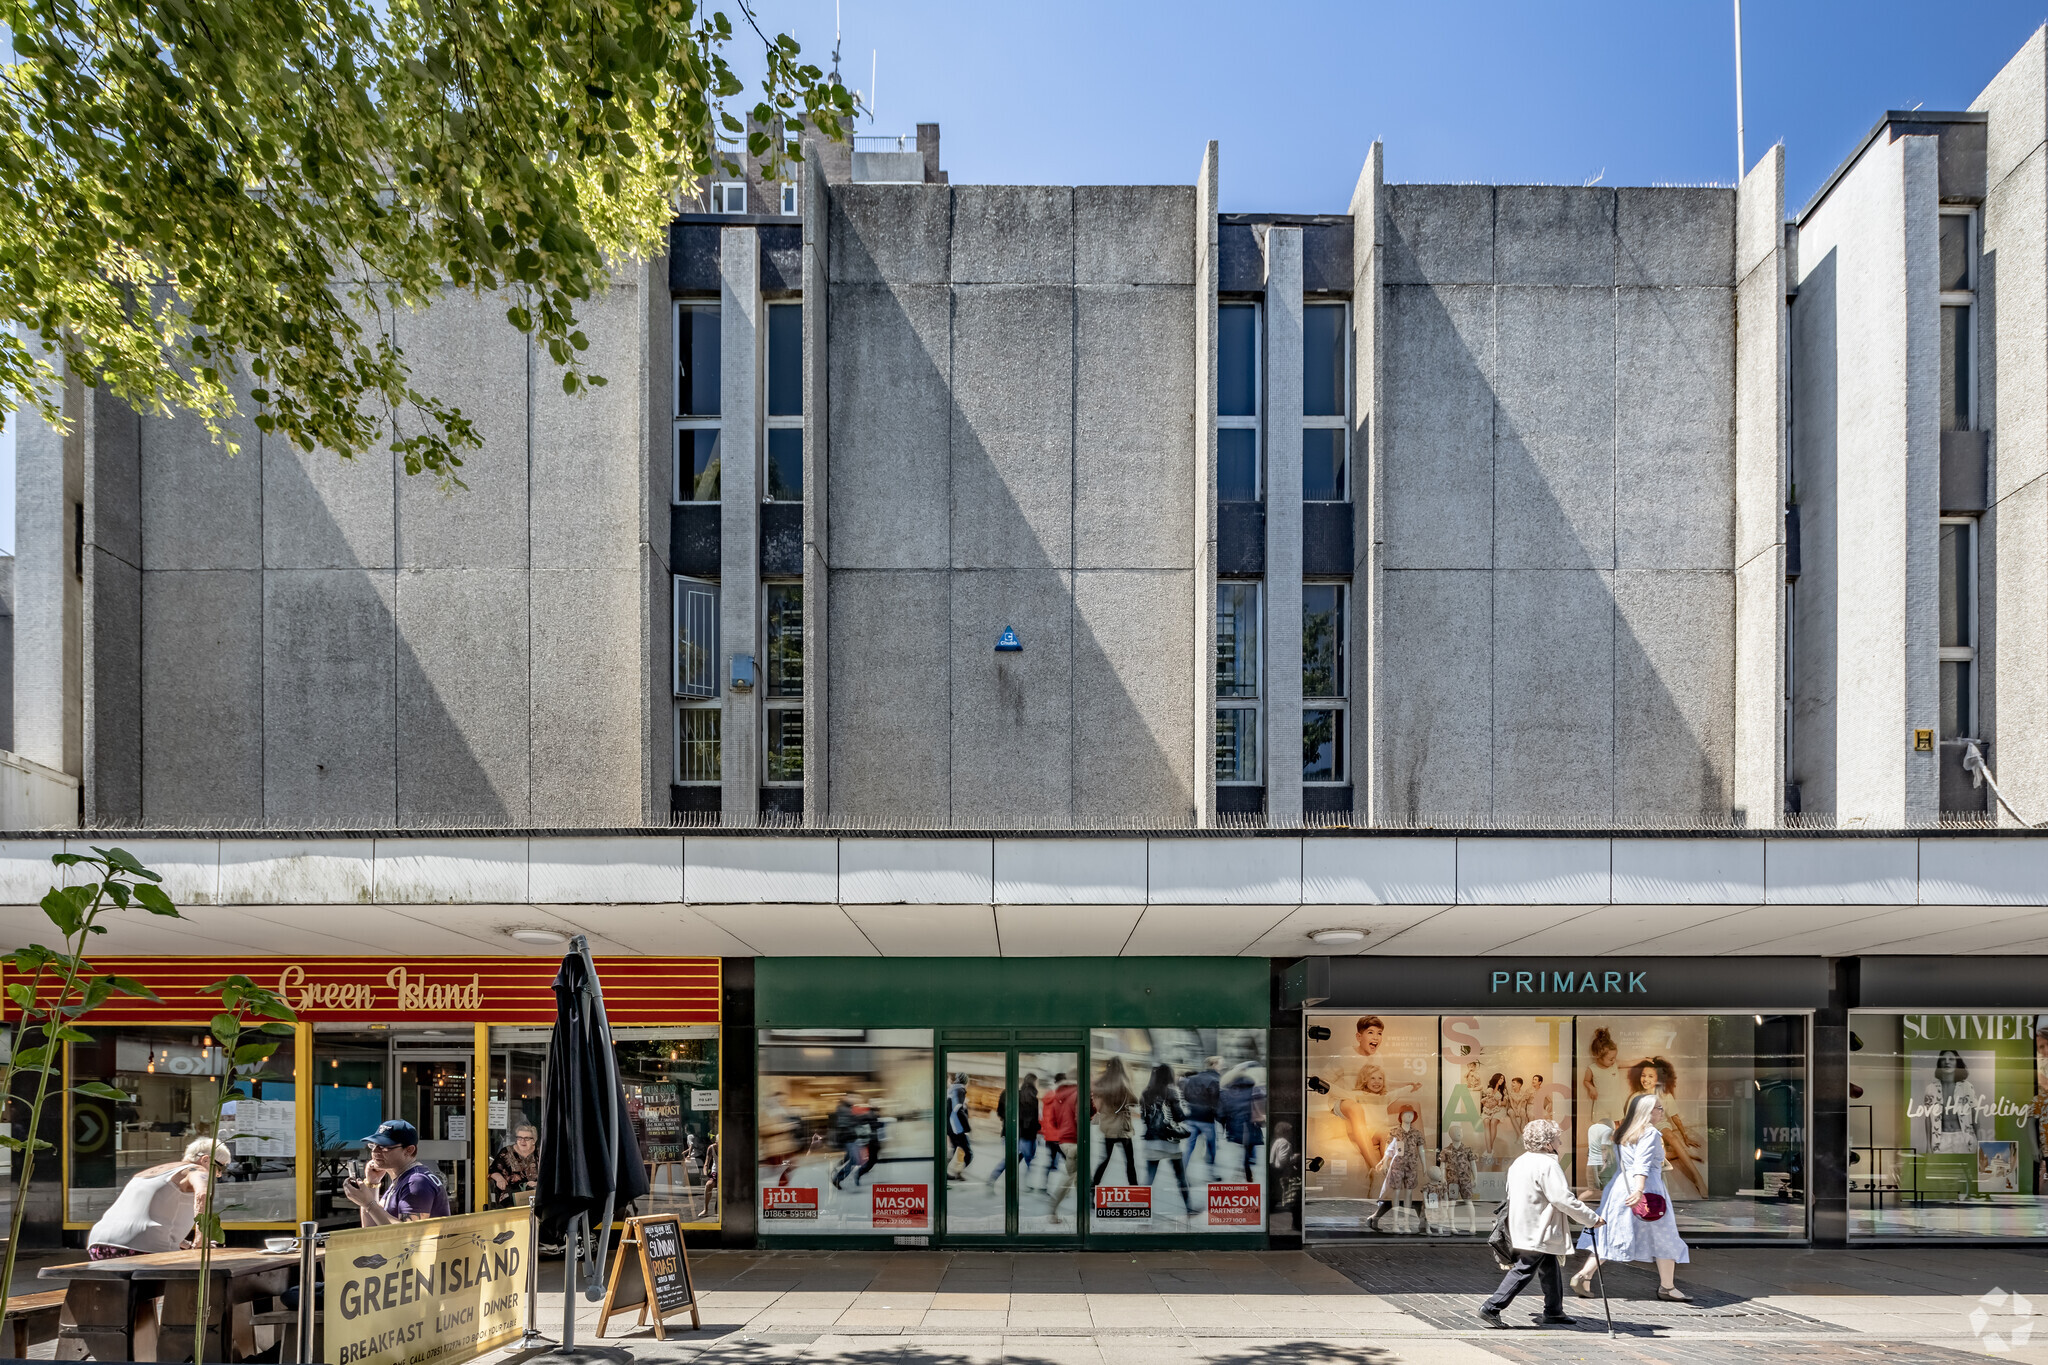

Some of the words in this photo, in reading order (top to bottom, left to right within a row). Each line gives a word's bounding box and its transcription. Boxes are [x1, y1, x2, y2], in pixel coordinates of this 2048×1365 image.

[278, 965, 376, 1013] Green
[386, 966, 484, 1012] Island
[1492, 971, 1648, 993] PRIMARK
[1903, 1014, 2035, 1040] SUMMER
[1403, 1057, 1428, 1076] £9
[1906, 1096, 1942, 1118] Love
[1944, 1095, 1971, 1118] the
[1972, 1094, 2029, 1129] feeling
[767, 1188, 798, 1206] jrbt
[875, 1197, 925, 1208] MASON
[1100, 1187, 1131, 1205] jrbt
[1210, 1195, 1259, 1207] MASON
[764, 1210, 787, 1218] 01865
[790, 1210, 817, 1218] 595143
[1097, 1209, 1120, 1217] 01865
[1123, 1209, 1150, 1217] 595143
[652, 1257, 677, 1276] ROAST
[340, 1263, 435, 1321] GREEN
[440, 1246, 520, 1295] ISLAND
[340, 1321, 424, 1365] BREAKFAST
[435, 1305, 474, 1333] LUNCH
[483, 1292, 519, 1318] DINNER
[409, 1352, 425, 1365] CALL
[462, 1335, 471, 1346] TO
[471, 1329, 488, 1342] BOOK
[488, 1323, 502, 1337] YOUR
[503, 1318, 518, 1330] TABLE
